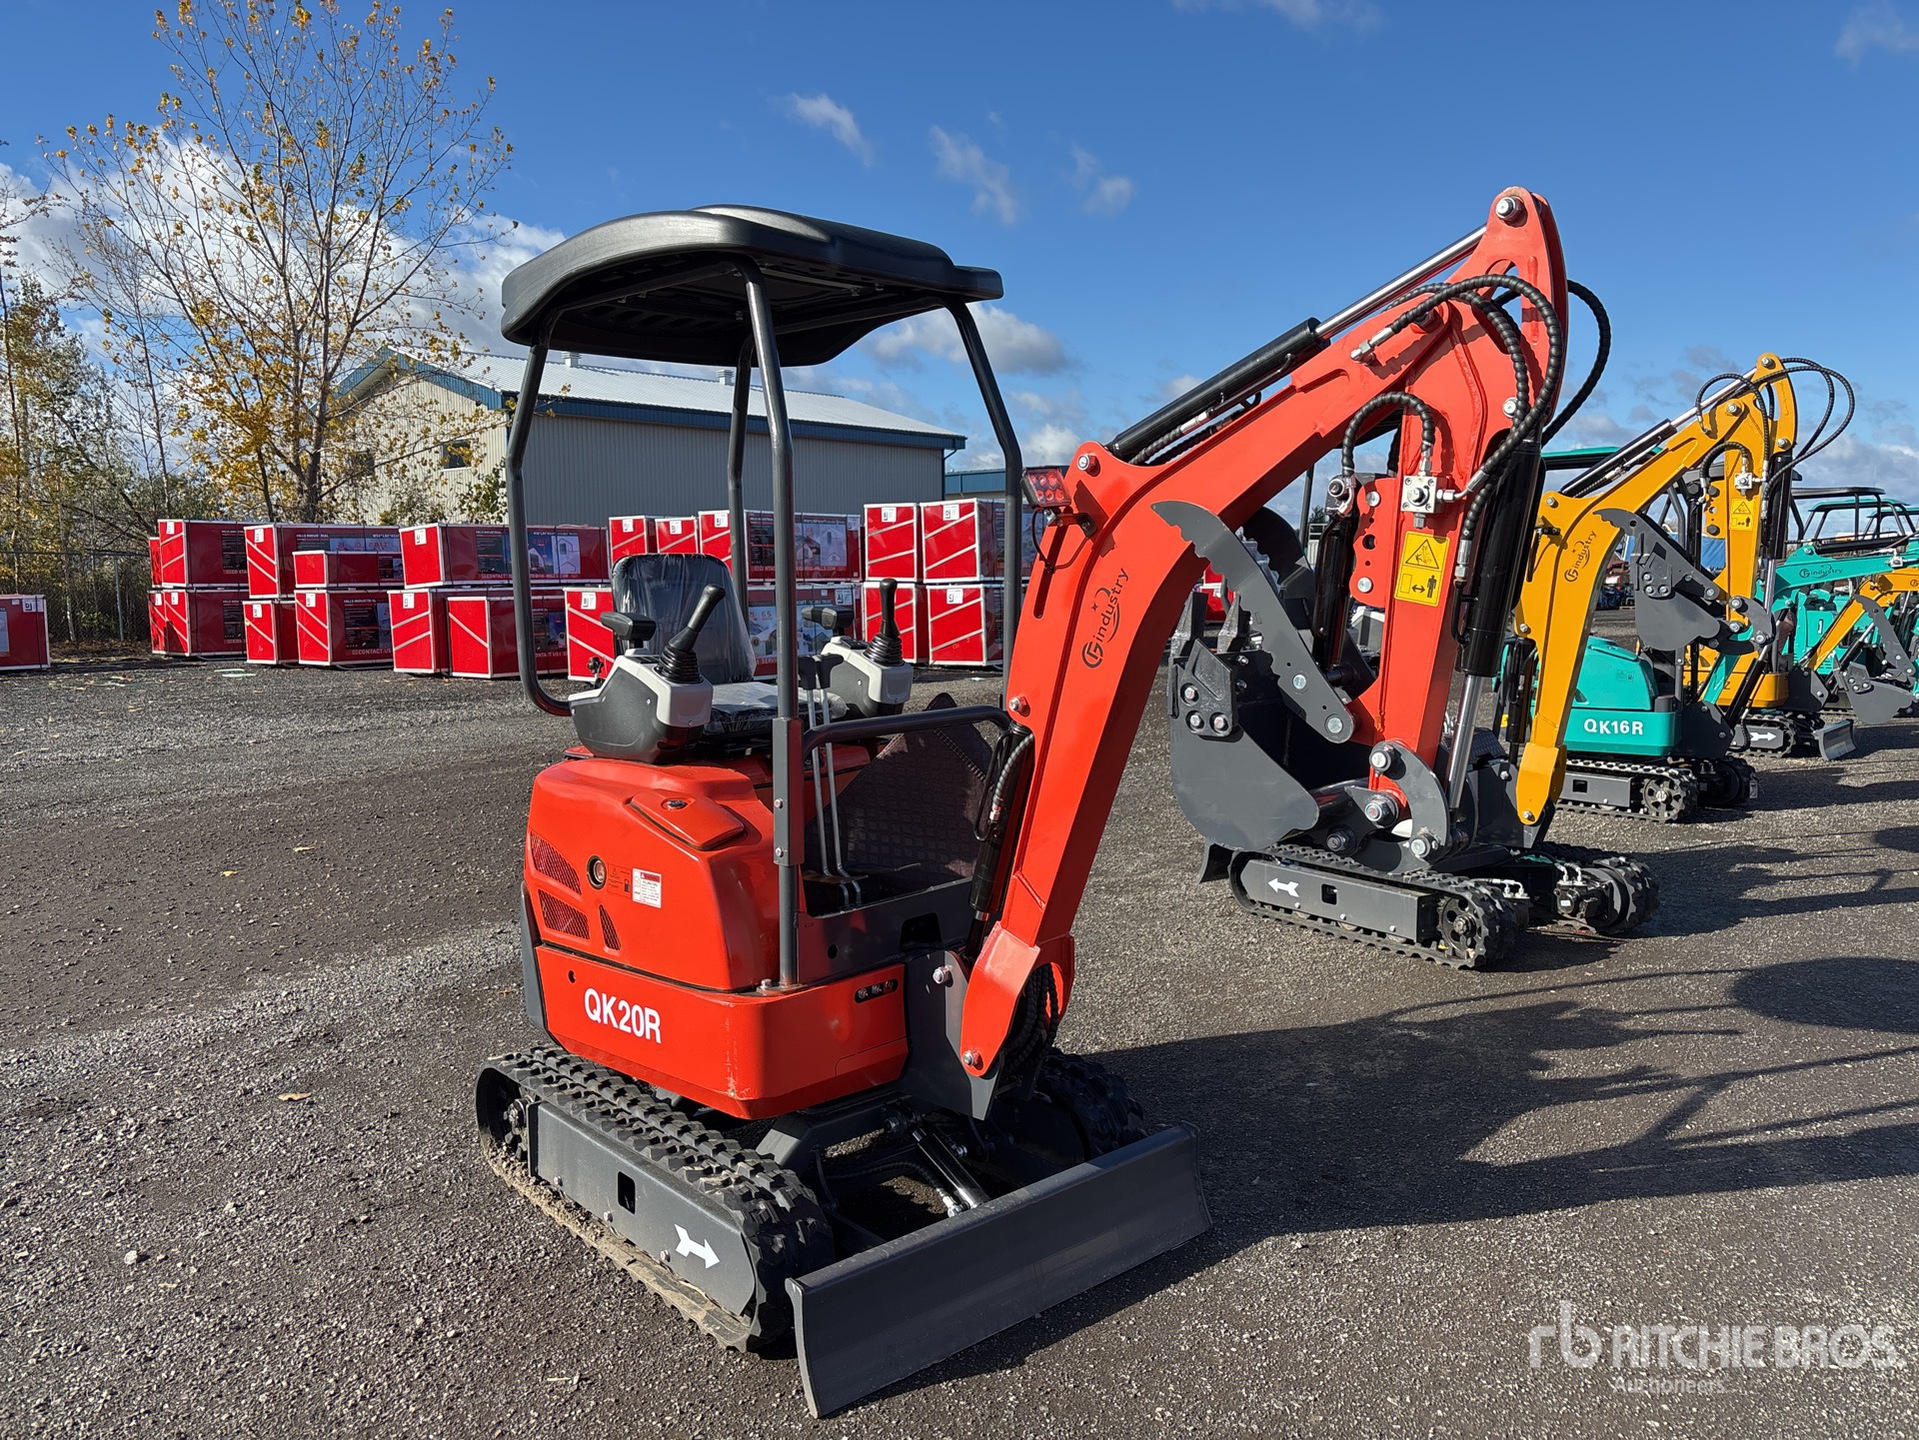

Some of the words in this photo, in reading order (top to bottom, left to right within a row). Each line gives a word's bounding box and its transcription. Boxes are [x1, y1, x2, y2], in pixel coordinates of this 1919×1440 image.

[1081, 567, 1129, 669] Gindustry
[1583, 718, 1644, 736] QK16R
[583, 988, 662, 1044] QK20R
